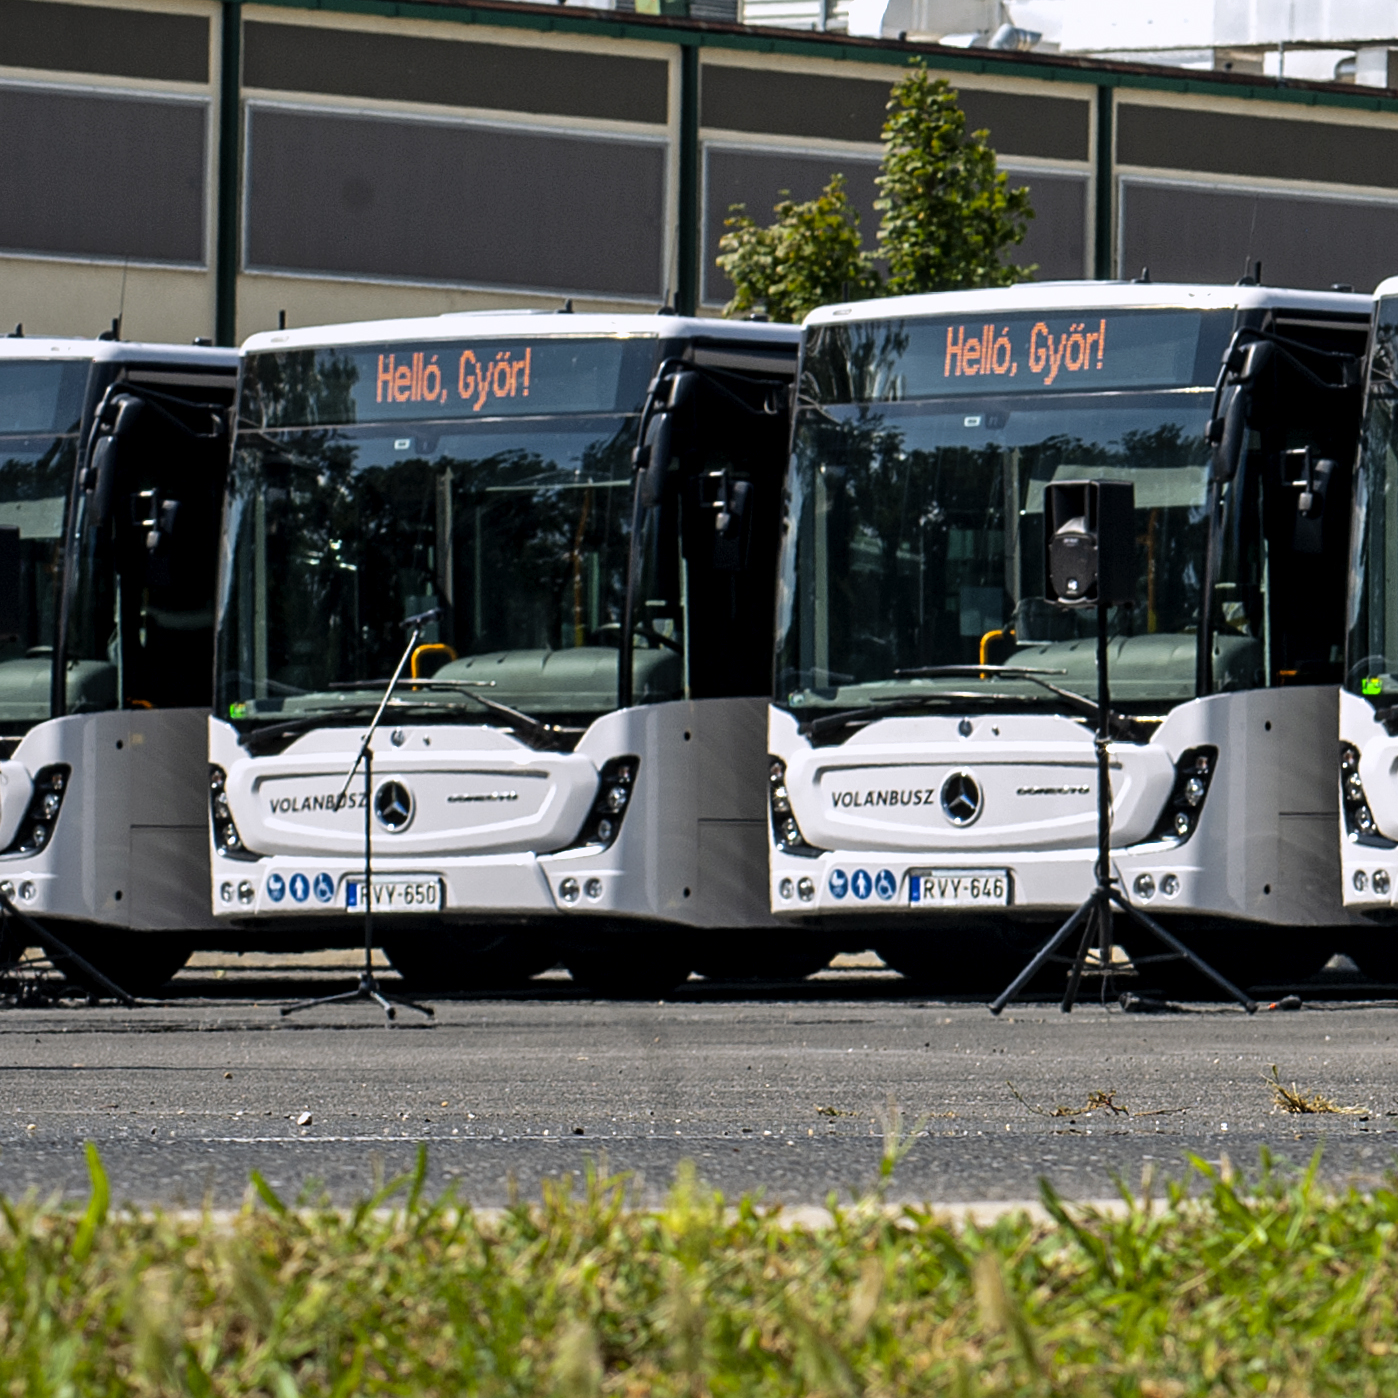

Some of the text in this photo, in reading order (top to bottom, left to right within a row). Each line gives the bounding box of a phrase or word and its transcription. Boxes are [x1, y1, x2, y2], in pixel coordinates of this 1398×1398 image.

[943, 318, 1107, 386] Helló, Győr!
[376, 347, 532, 412] Helló, Győr!
[831, 788, 934, 808] VOLÁNBUSZ
[360, 883, 436, 905] RVY-650
[923, 878, 1004, 899] RVY-646
